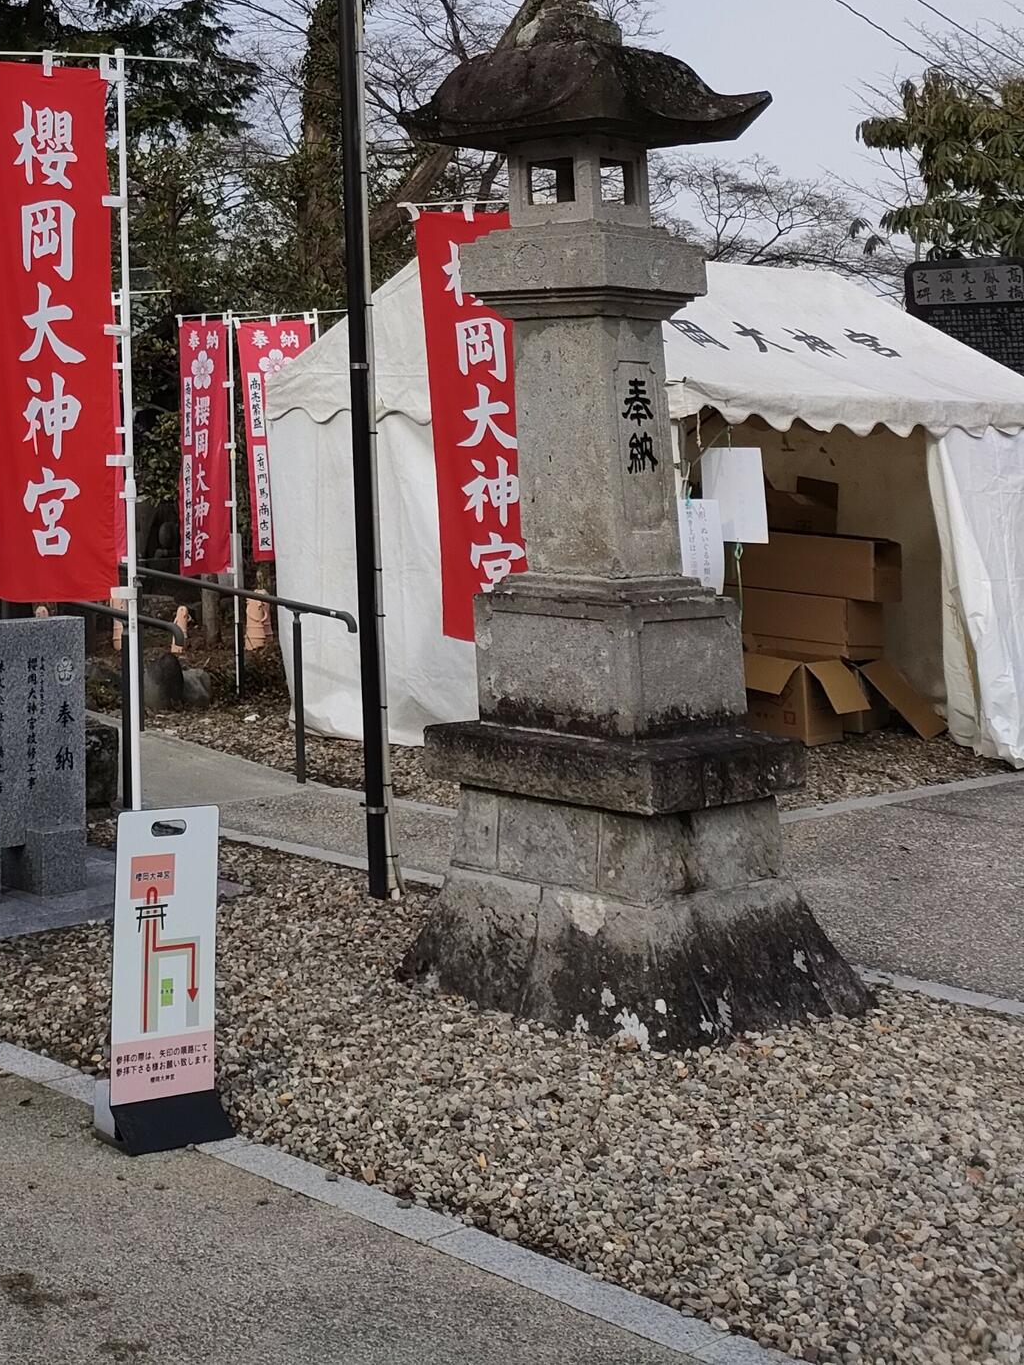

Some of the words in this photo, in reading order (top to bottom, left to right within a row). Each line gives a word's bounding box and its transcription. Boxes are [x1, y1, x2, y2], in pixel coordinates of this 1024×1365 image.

[960, 269, 977, 302] 先生
[12, 100, 87, 557] 櫻岡大神宮
[188, 329, 219, 351] 奉納
[251, 329, 300, 349] 奉納
[663, 319, 903, 360] 岡大神宮
[621, 377, 658, 474] 奉納
[193, 395, 211, 562] 櫻岡大神宮
[56, 700, 75, 771] 奉納
